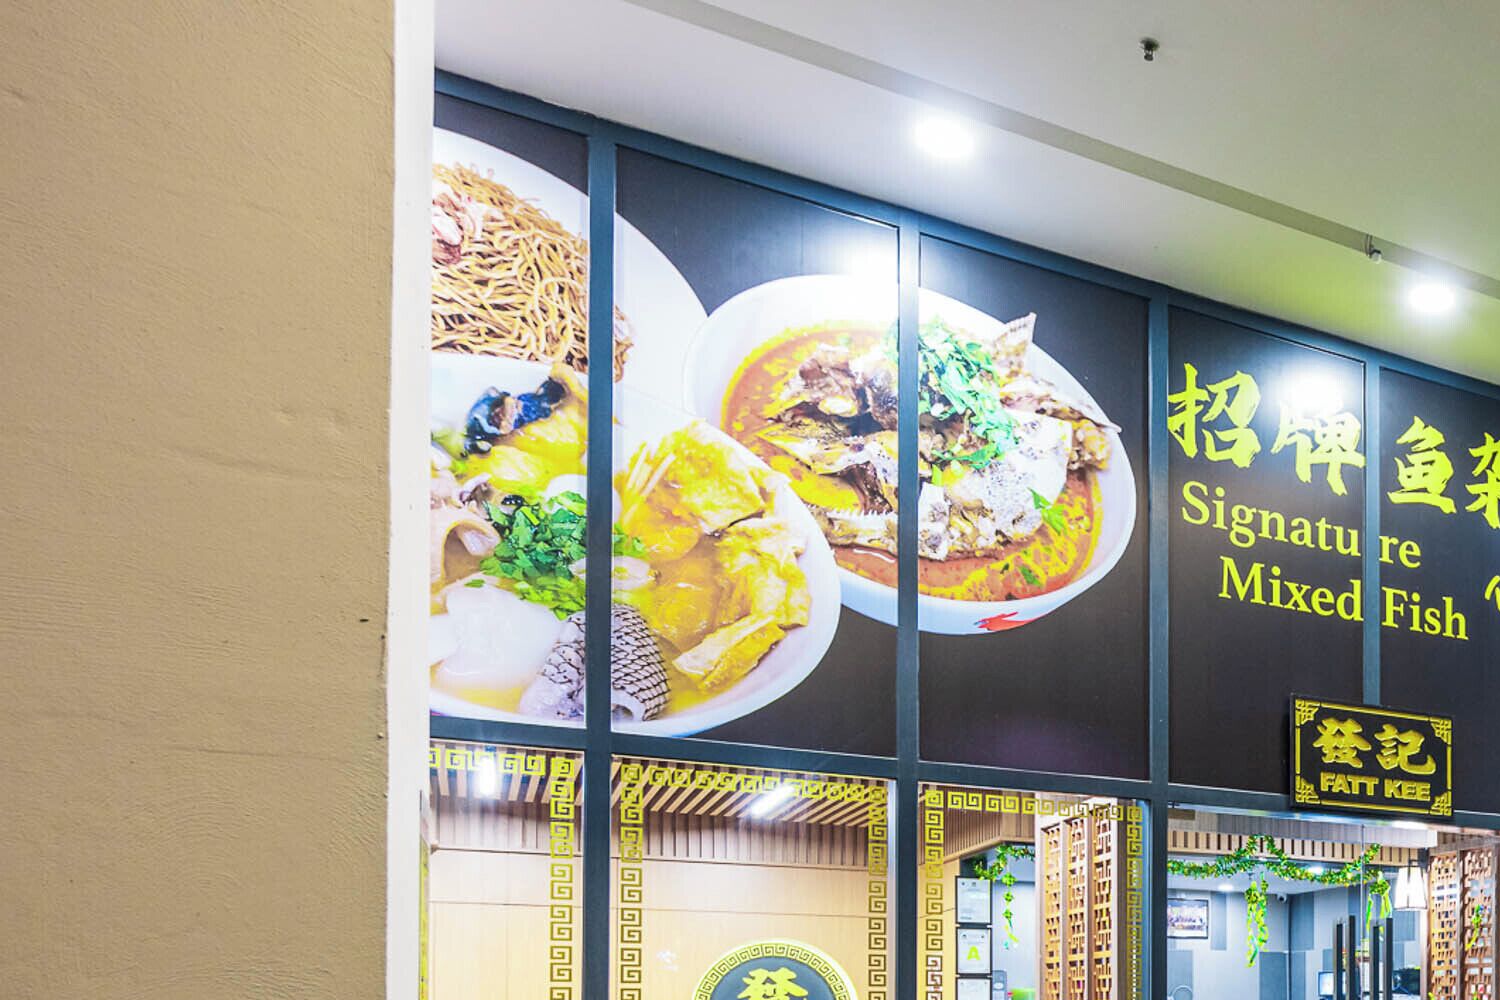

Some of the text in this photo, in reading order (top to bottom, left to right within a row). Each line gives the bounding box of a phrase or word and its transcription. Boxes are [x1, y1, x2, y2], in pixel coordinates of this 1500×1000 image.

[1182, 480, 1422, 569] Signature
[1218, 555, 1469, 640] Mixed Fish
[1313, 718, 1437, 775] 發記
[1320, 772, 1431, 801] FATT KEE
[967, 945, 981, 961] A
